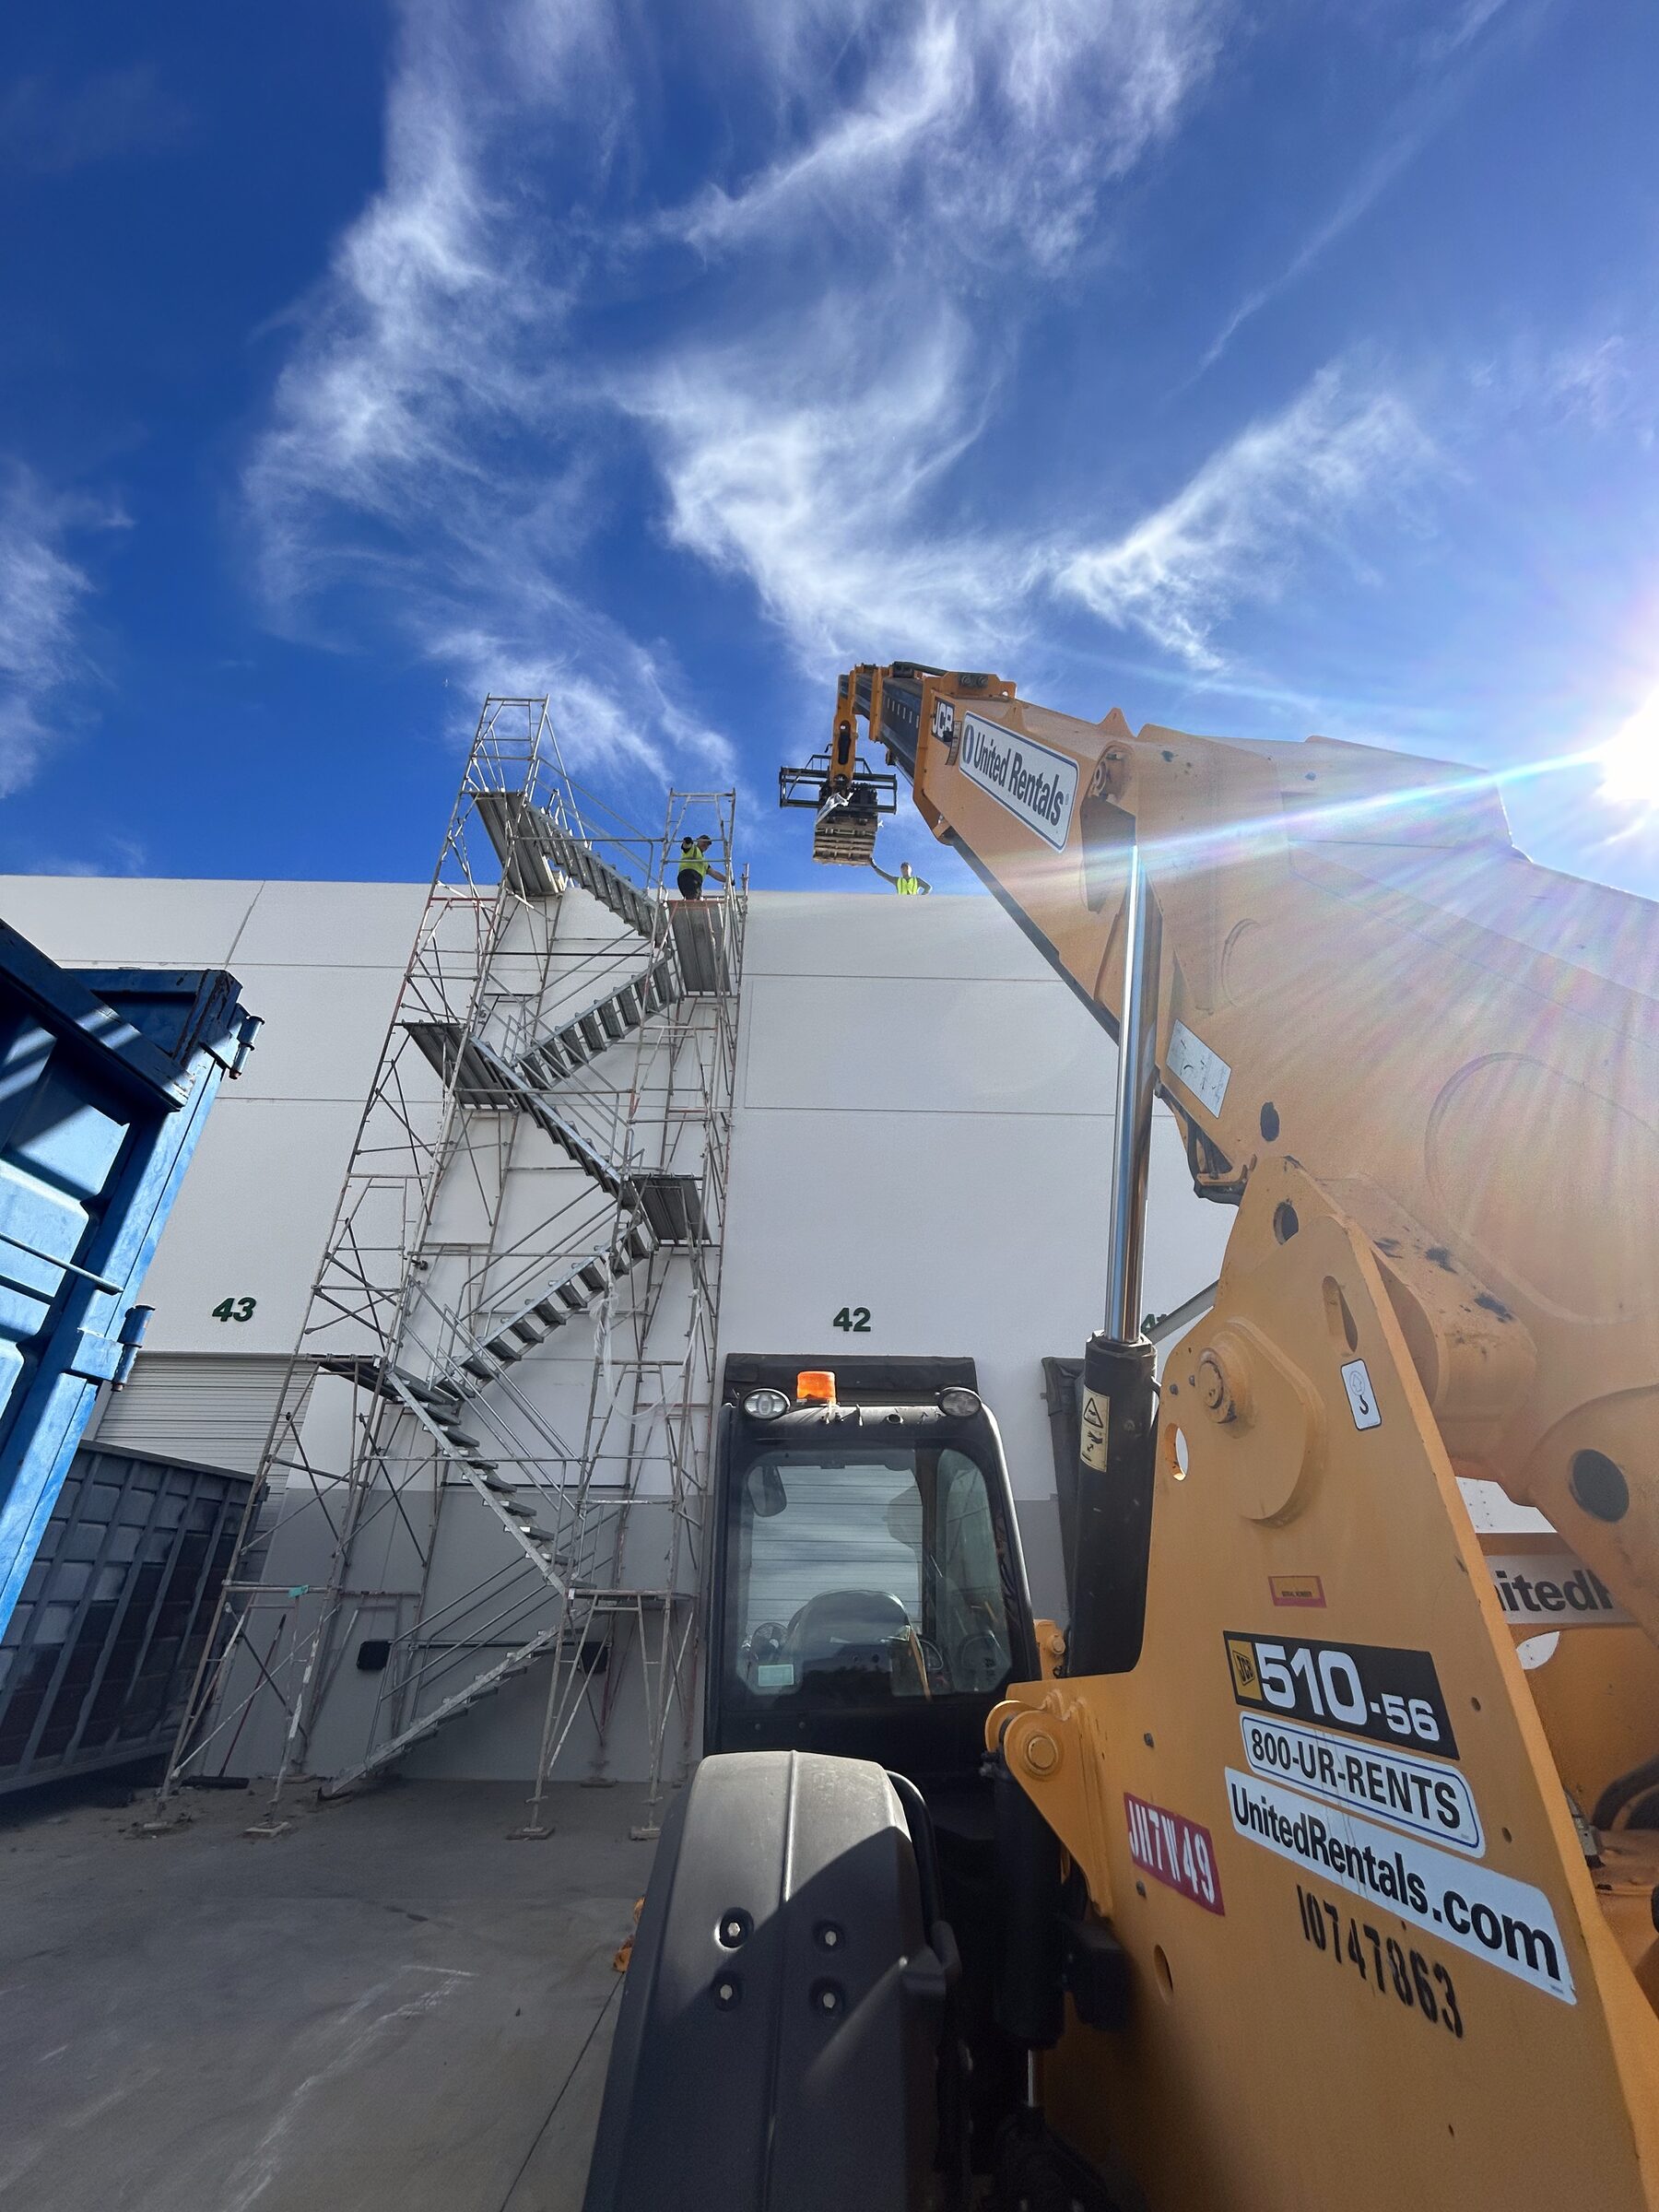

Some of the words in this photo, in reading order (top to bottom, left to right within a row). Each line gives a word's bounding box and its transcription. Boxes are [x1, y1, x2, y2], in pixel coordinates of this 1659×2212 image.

[973, 732, 1011, 787] United
[1007, 751, 1065, 827] Rentals
[212, 1297, 257, 1322] 43
[832, 1307, 871, 1332] 42
[1254, 1642, 1441, 1741] 510-56
[1251, 1728, 1461, 1830] 800-UR-RENTS
[1230, 1783, 1561, 1982] UnitedRentals.com
